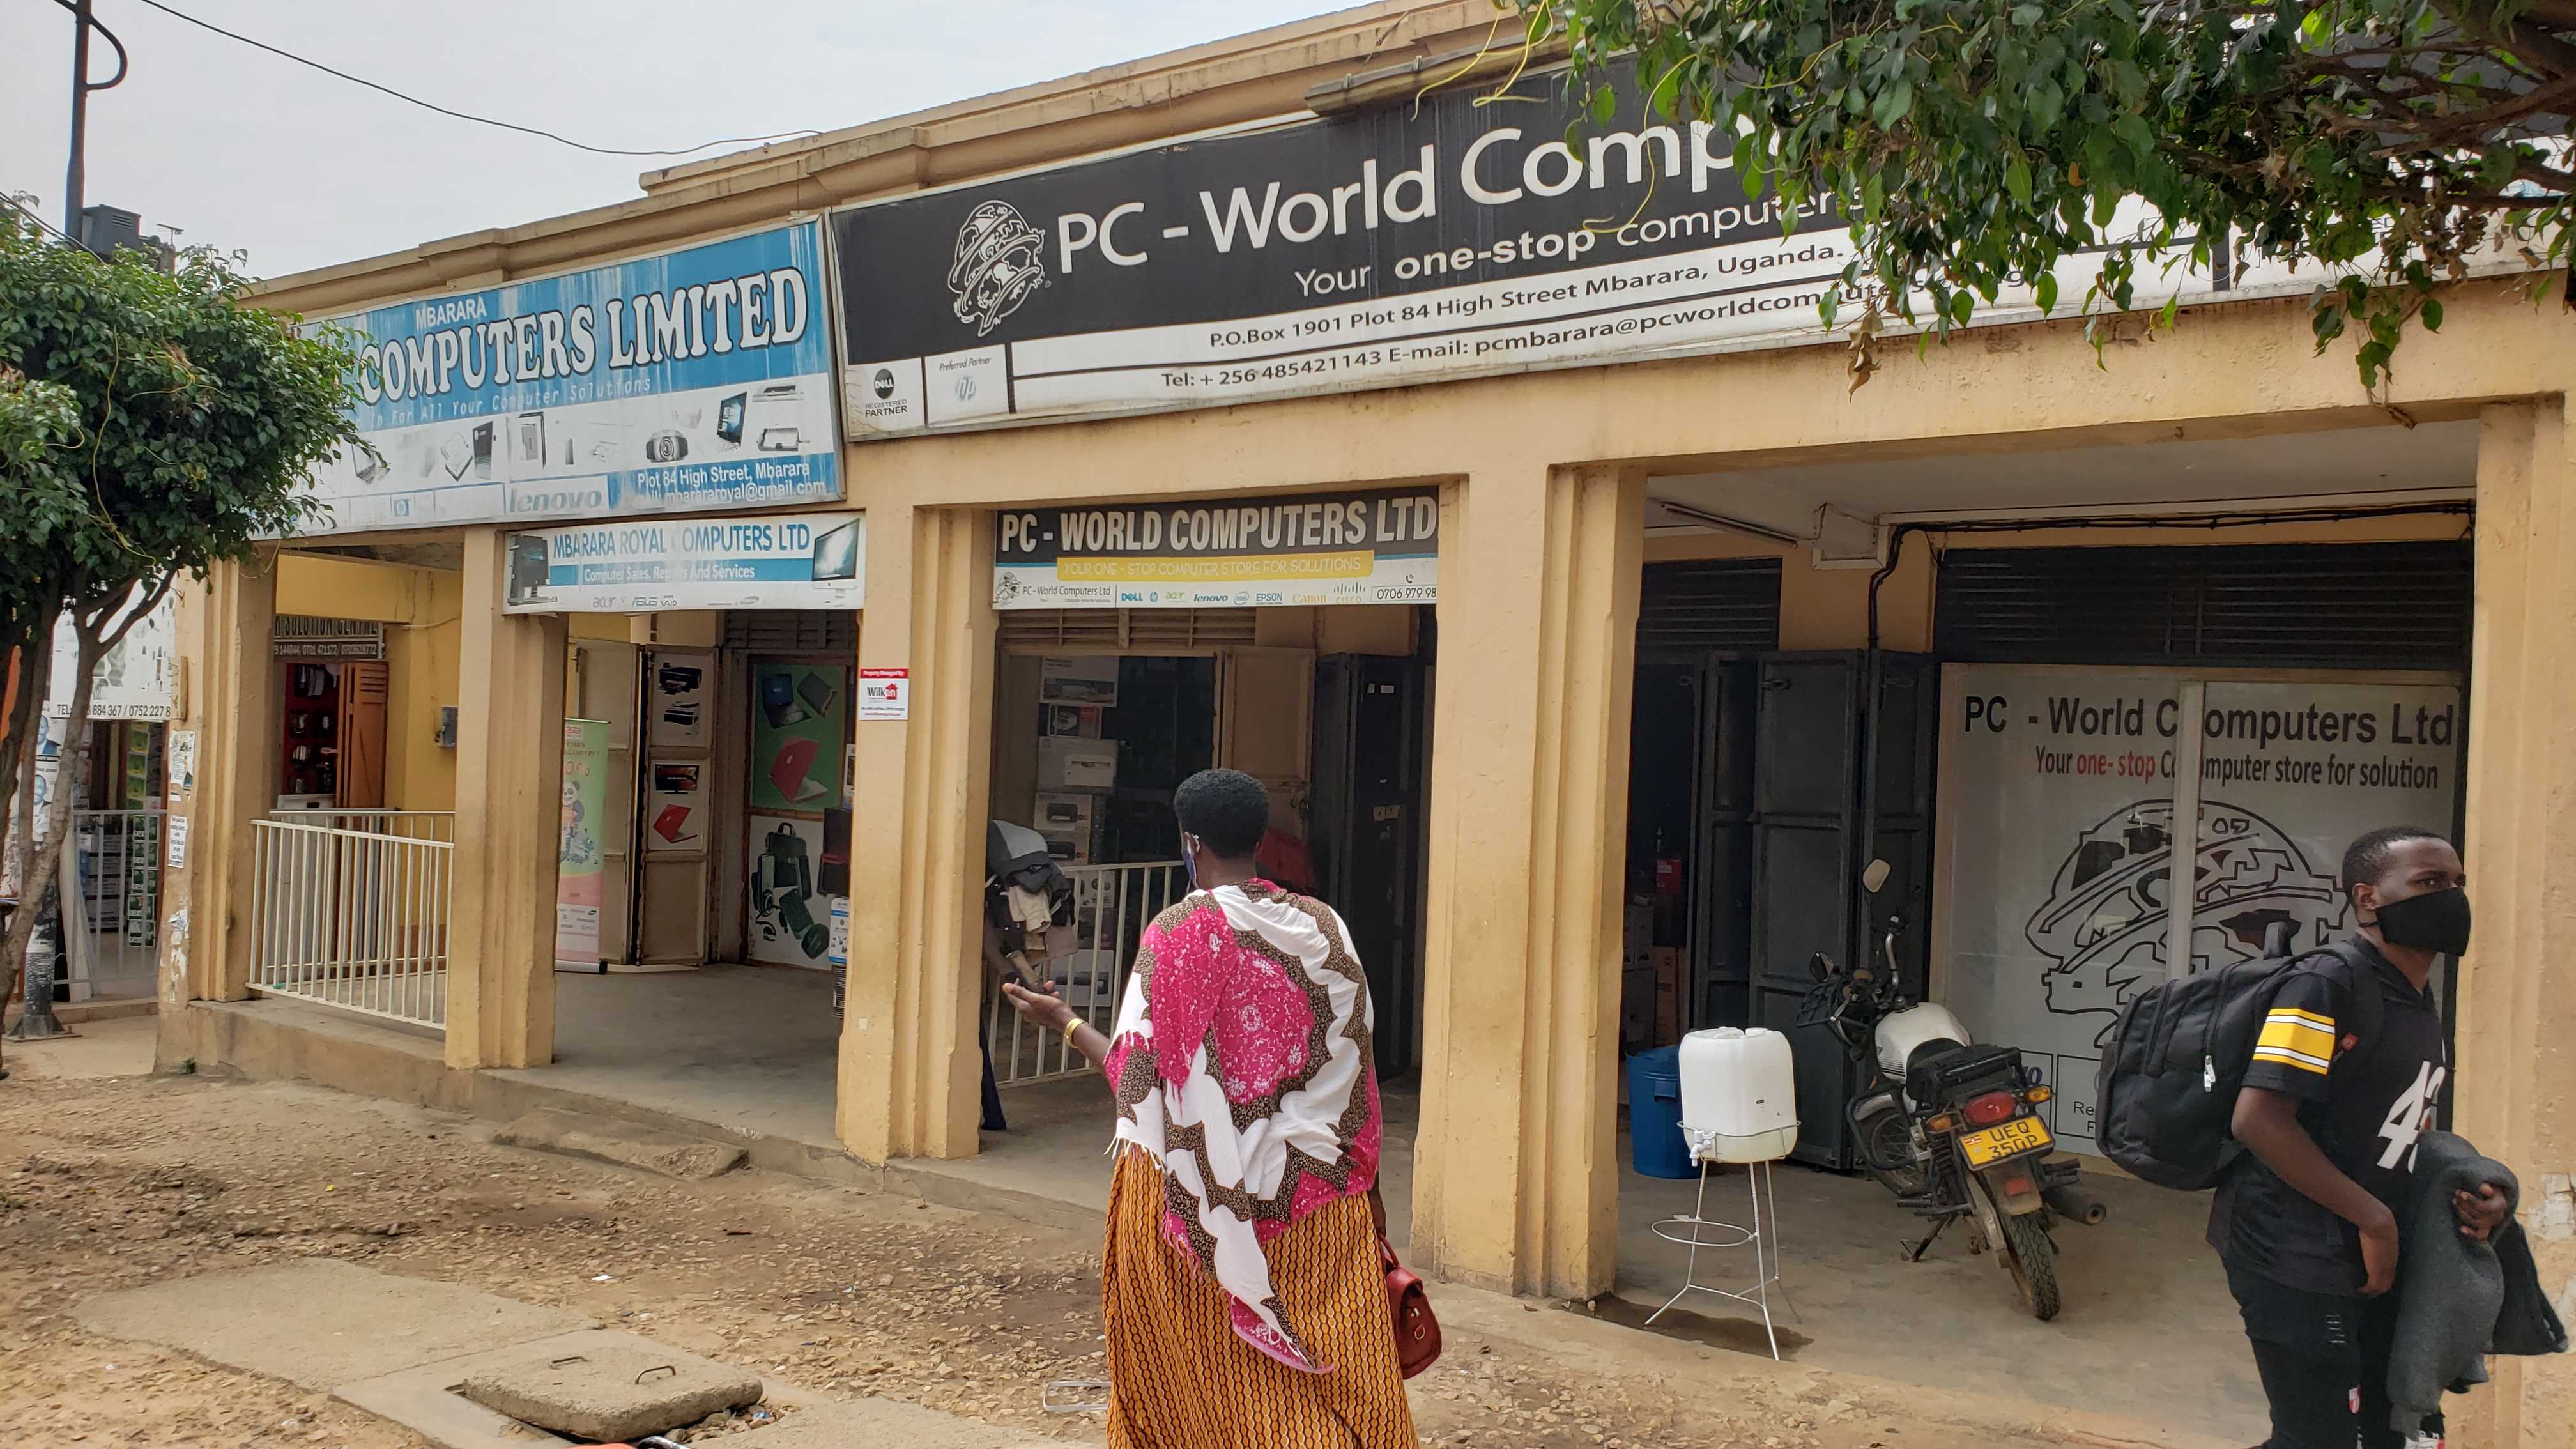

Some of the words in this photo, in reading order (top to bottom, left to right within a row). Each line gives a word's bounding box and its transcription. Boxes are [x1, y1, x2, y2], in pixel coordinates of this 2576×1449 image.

[1058, 202, 1147, 273] PC
[1163, 226, 1189, 238] -
[1199, 144, 1436, 252] World
[1460, 114, 1781, 204] Comp
[1295, 266, 1371, 297] Your
[1395, 226, 1595, 279] one-stop
[1210, 326, 1285, 348] P.O.Box
[1292, 317, 1341, 337] 1901
[1351, 310, 1395, 329] Plot
[1401, 305, 1430, 321] 84
[1437, 296, 1493, 317] High
[1501, 283, 1577, 308] Street
[1585, 265, 1708, 296] Mbarara,
[1717, 243, 1843, 273] Uganda.
[416, 296, 487, 331] MBARARA
[359, 304, 597, 406] COMPUTERS
[606, 266, 808, 369] LIMITED
[939, 358, 967, 372] Preferred
[968, 356, 992, 367] Partner
[1162, 372, 1195, 387] Tel:
[1219, 369, 1256, 387] 256
[1262, 351, 1381, 380] 485421143
[1389, 340, 1469, 363] E-mail:
[874, 378, 894, 390] DELL
[420, 405, 442, 422] All
[452, 399, 484, 415] Your
[570, 378, 650, 401] Solutions
[865, 399, 907, 410] REGISTERED
[865, 406, 908, 418] PARTNER
[638, 472, 660, 490] Plot
[663, 471, 677, 484] 84
[680, 468, 707, 488] High
[710, 464, 753, 484] Street,
[755, 461, 810, 479] Mbarara
[511, 489, 602, 512] lenovo
[1001, 514, 1038, 552] PC
[1060, 510, 1162, 551] WORLD
[1170, 500, 1367, 551] COMPUTERS
[1376, 496, 1437, 542] LTD
[554, 528, 616, 559] MBARARA
[620, 526, 668, 555] ROYAL
[671, 524, 772, 553] OMPUTERS
[779, 523, 810, 551] LTD
[689, 566, 709, 579] And
[712, 564, 755, 579] Services
[1064, 564, 1092, 576] YOUR
[1093, 564, 1117, 576] ONE
[1128, 562, 1155, 576] STOP
[1158, 562, 1217, 576] COMPUTER
[1222, 561, 1260, 574] STORE
[1263, 560, 1287, 573] FOR
[1290, 557, 1361, 573] SOLUTIONS
[1038, 586, 1058, 595] World
[1059, 585, 1097, 597] Computers
[1099, 586, 1111, 595] Ltd
[1121, 592, 1143, 602] DELL
[1193, 594, 1228, 602] lenovo
[1256, 593, 1282, 601] EPSON
[1292, 593, 1326, 603] Canon
[1377, 588, 1402, 599] 0706
[1405, 588, 1423, 599] 979
[867, 687, 896, 697] Wilken
[93, 705, 106, 716] 884
[108, 705, 122, 716] 367
[129, 705, 148, 716] 0752
[150, 705, 164, 717] 227
[1965, 696, 2007, 733] PC
[2048, 697, 2144, 736] World
[2156, 698, 2376, 749] Computers
[2391, 703, 2453, 746] Ltd
[2035, 746, 2073, 774] Your
[2275, 755, 2322, 785] store
[2327, 753, 2355, 786] for
[2360, 755, 2438, 790] solution
[2074, 1101, 2096, 1116] Re
[1989, 1121, 2031, 1143] UEQ
